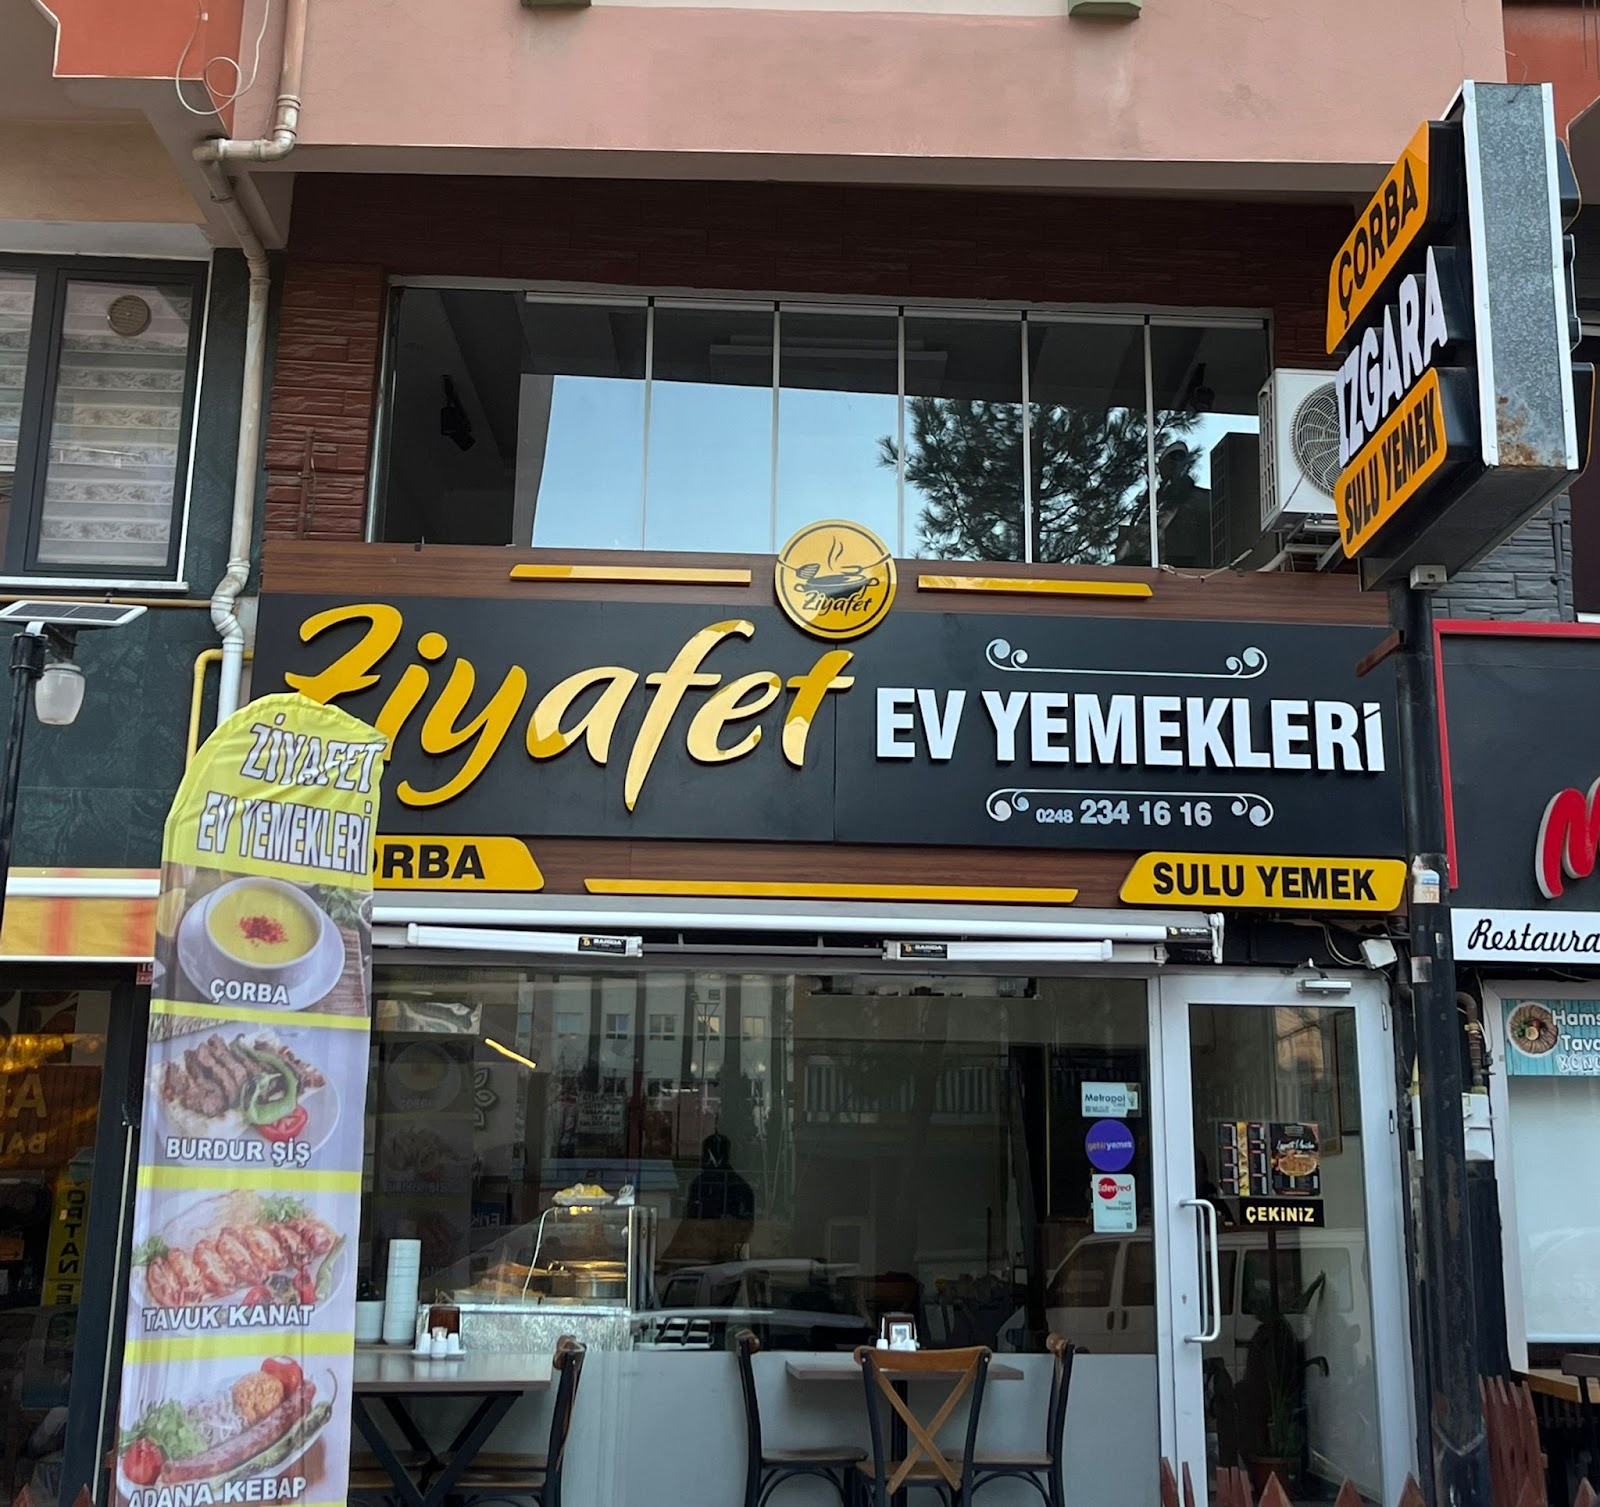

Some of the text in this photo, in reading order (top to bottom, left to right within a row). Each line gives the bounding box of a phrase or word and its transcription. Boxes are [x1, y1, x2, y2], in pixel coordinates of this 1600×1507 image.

[1338, 157, 1418, 329] ÇORBA
[1335, 245, 1448, 468] IZGARA
[1344, 387, 1439, 545] SULU YEMEK
[802, 591, 872, 617] Ziyafet
[285, 603, 855, 812] Ziyafet
[876, 687, 967, 761] EV
[239, 713, 387, 794] ZİYAFET
[1035, 799, 1212, 827] 0248 234 16 16
[197, 791, 372, 876] EV YEMEKLERİ
[373, 844, 485, 879] RBA
[1153, 862, 1244, 896] SULU
[1258, 866, 1377, 901] YEMEK
[210, 979, 290, 1005] ÇORBA
[165, 1136, 312, 1168] BURDUR ŞİŞ
[143, 1303, 315, 1332] TAVUK KANAT
[129, 1476, 308, 1507] ADANA KEBAP
